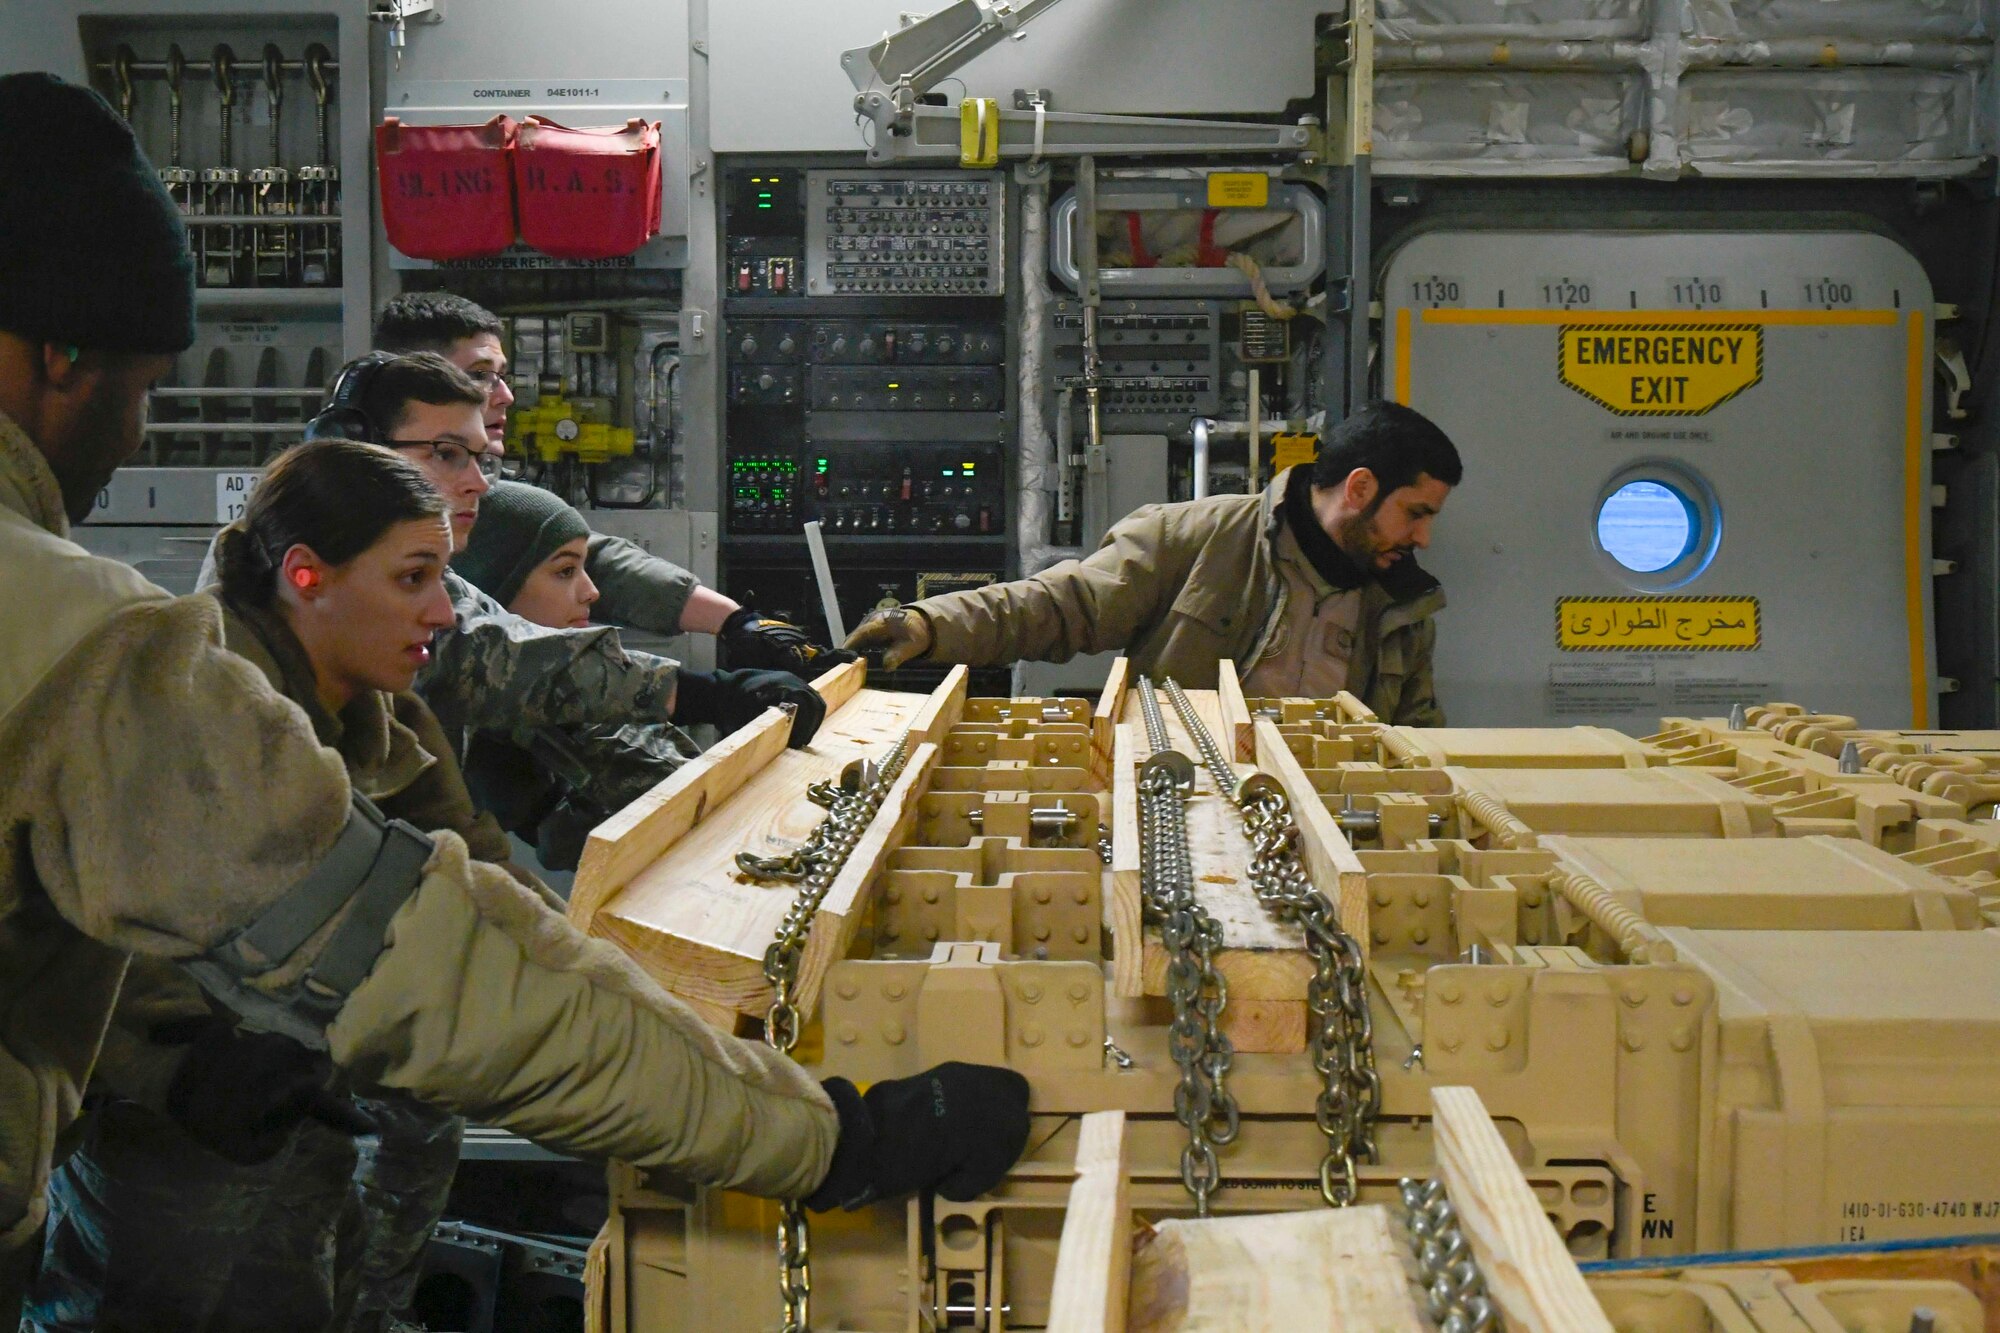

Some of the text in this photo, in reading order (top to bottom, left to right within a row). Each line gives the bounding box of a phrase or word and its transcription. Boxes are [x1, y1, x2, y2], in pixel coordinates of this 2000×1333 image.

[473, 89, 531, 98] CONTAINER
[588, 255, 636, 267] SYSTEM
[1412, 281, 1460, 301] 1130
[1543, 284, 1591, 304] 1120
[1673, 283, 1722, 304] 1110
[1804, 283, 1852, 304] 1100
[1576, 336, 1744, 365] EMERGENCY
[1630, 376, 1690, 404] EXIT
[225, 476, 245, 492] AD
[1570, 607, 1746, 640] مخرج الطوارئ
[1643, 1193, 1657, 1213] E
[1850, 1226, 1866, 1242] EA
